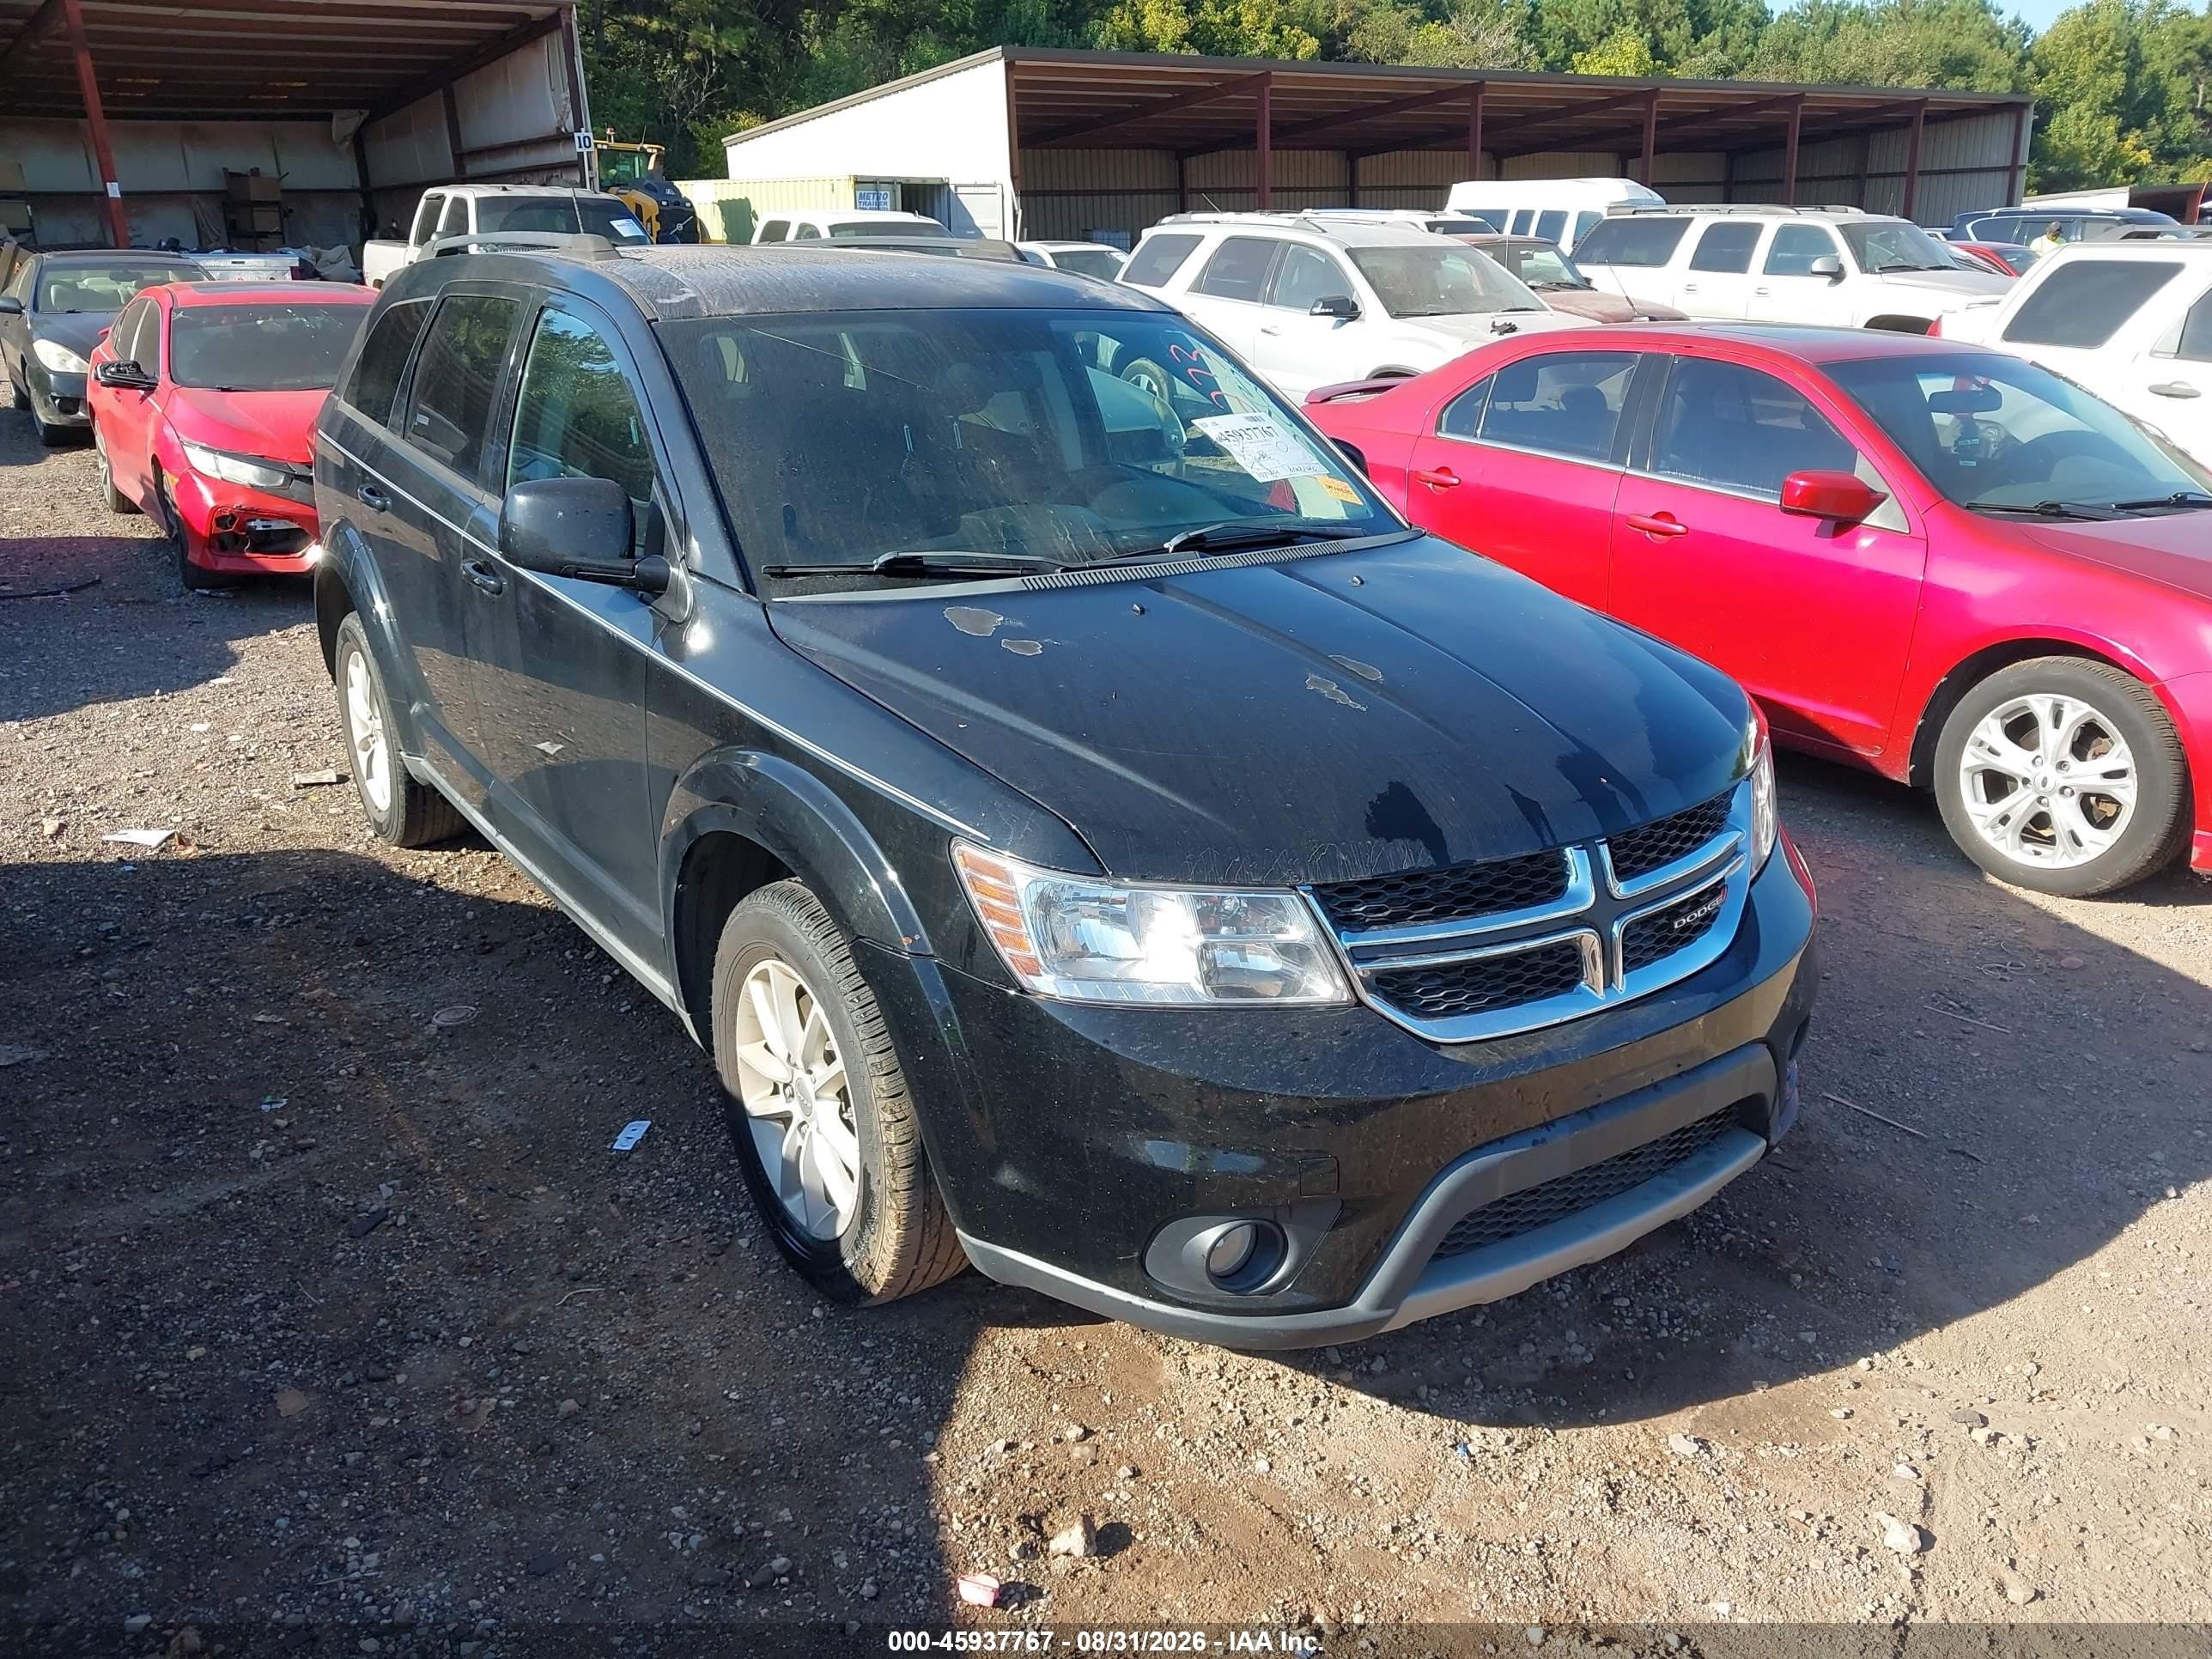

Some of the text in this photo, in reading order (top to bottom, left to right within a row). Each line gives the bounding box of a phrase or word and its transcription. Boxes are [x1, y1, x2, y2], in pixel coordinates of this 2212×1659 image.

[577, 135, 592, 149] 10
[859, 192, 888, 201] METRO
[1674, 896, 1723, 929] DODGE
